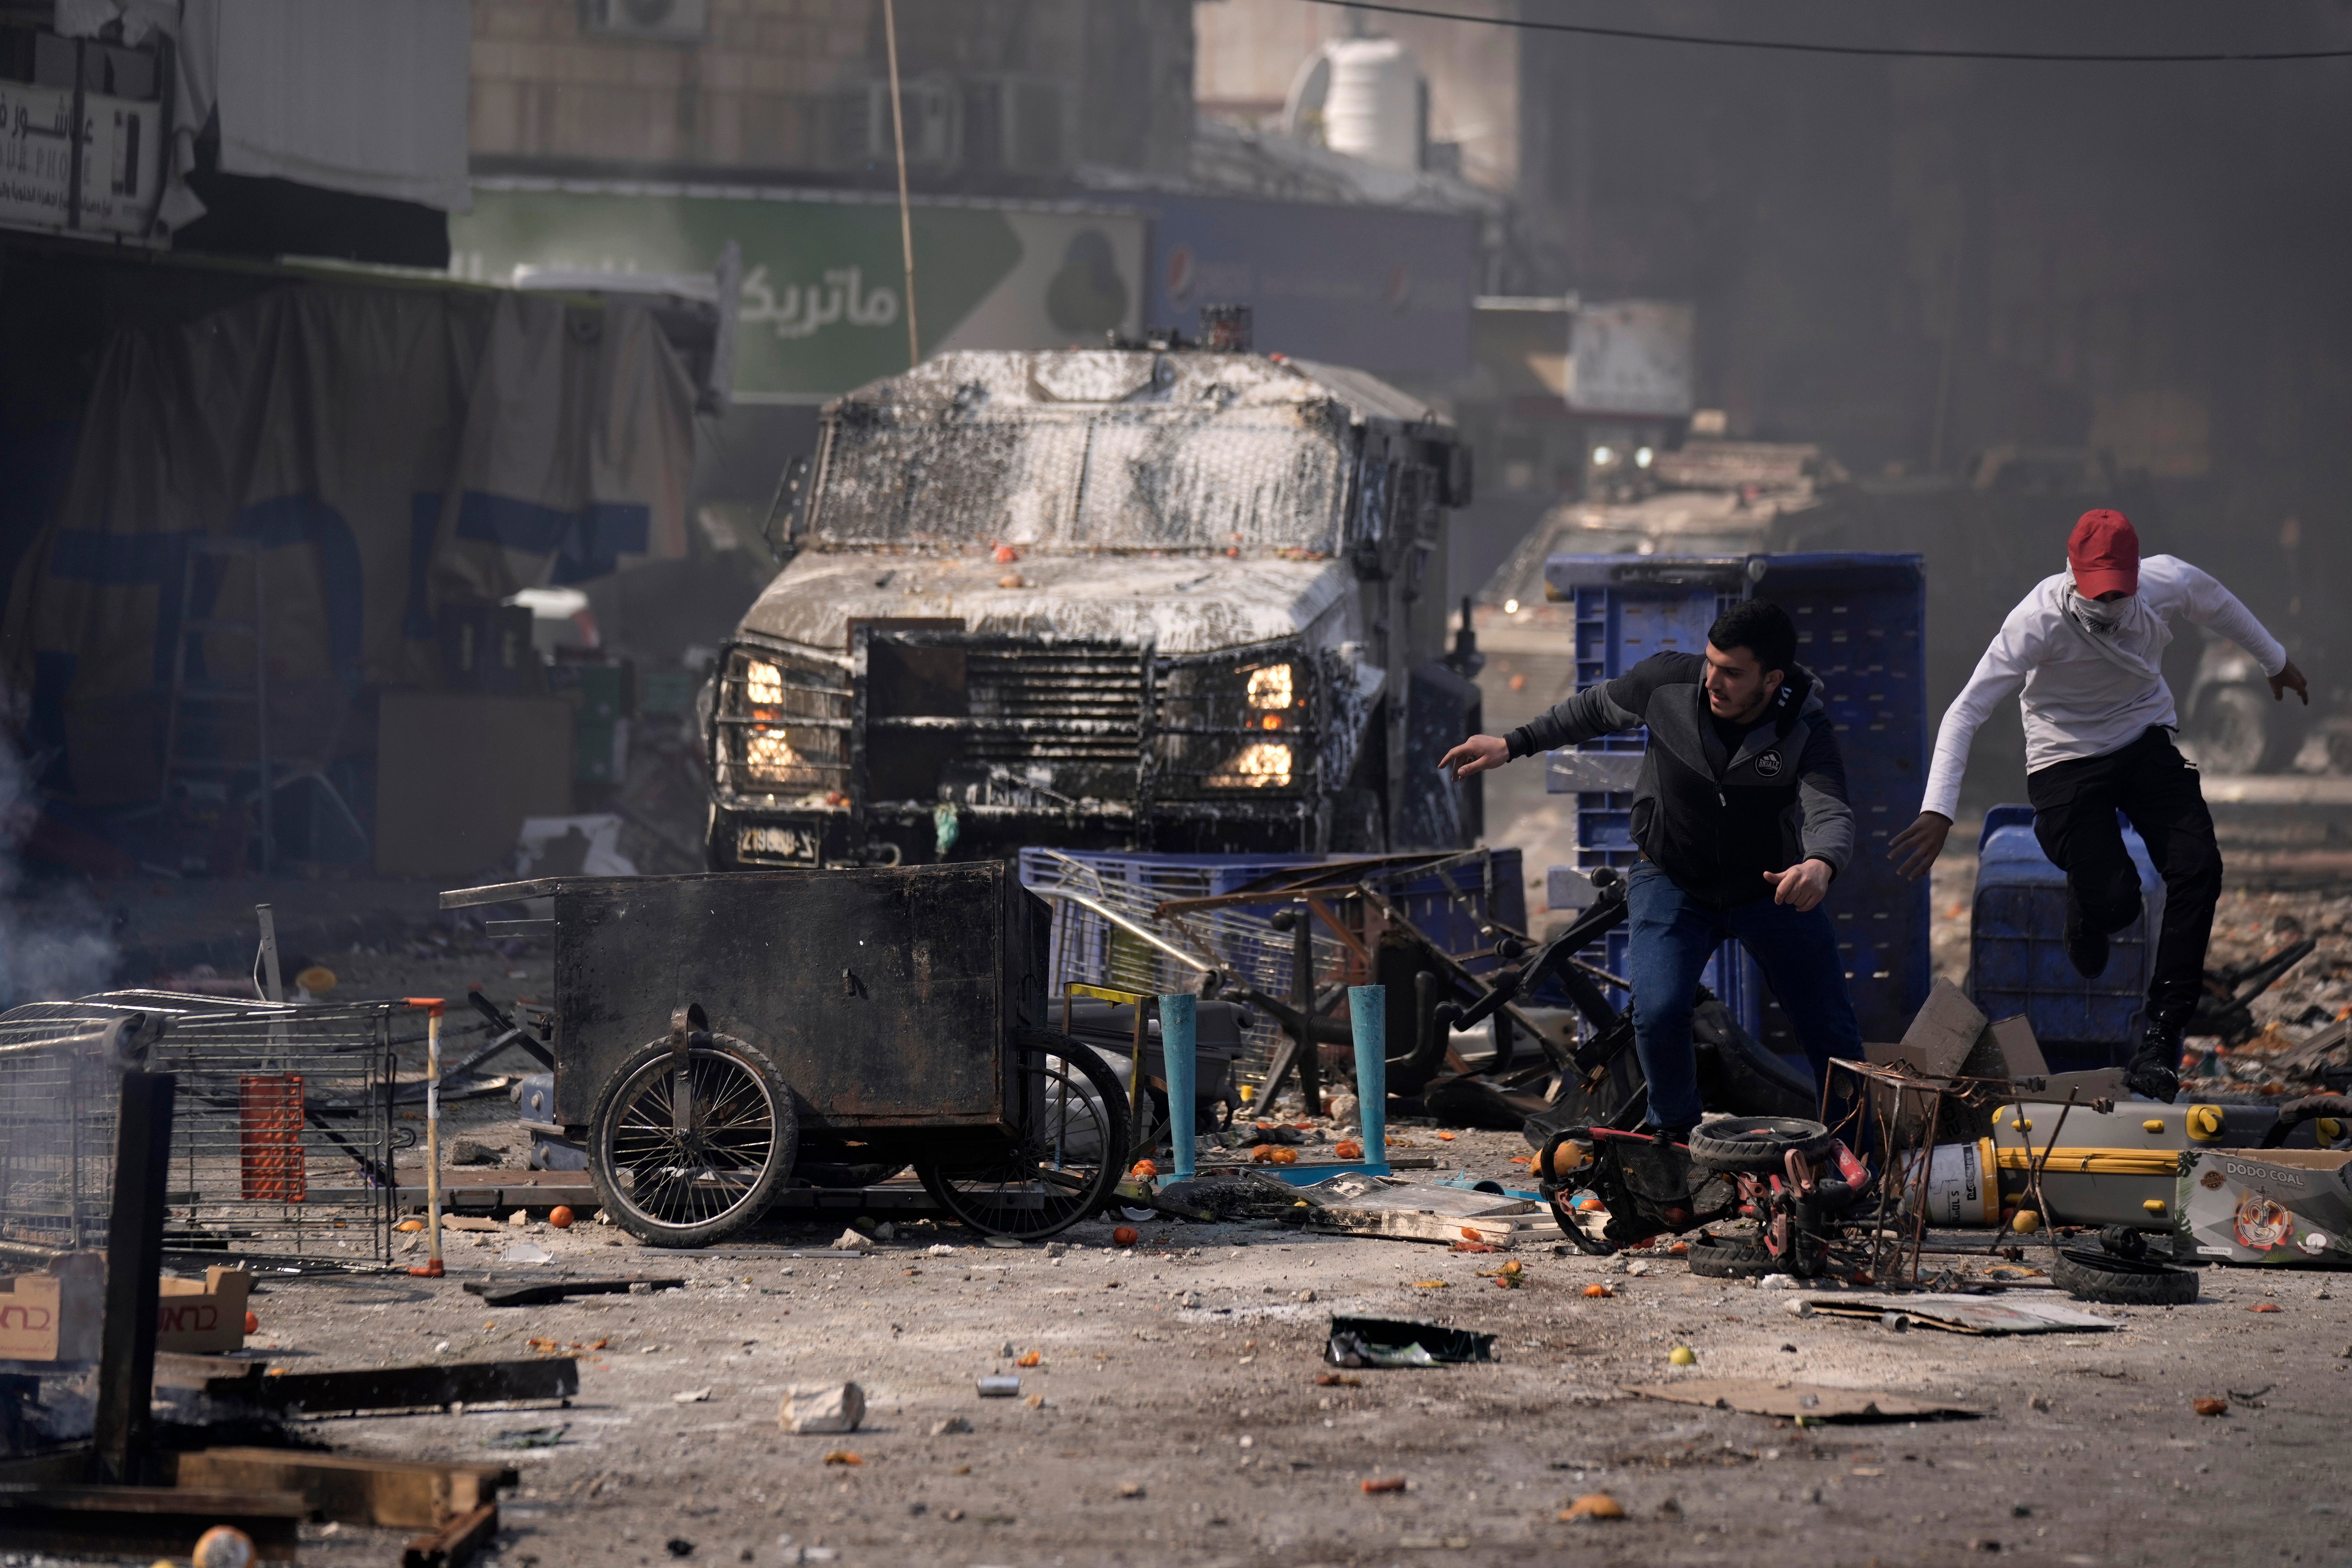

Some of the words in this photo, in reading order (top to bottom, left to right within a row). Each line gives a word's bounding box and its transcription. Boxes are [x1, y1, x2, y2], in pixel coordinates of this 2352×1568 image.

[36, 147, 91, 186] PHOE
[740, 264, 899, 338] ماتريك
[1759, 759, 1779, 770] BNSALE
[2201, 1175, 2226, 1186] ORIGINAL
[2226, 1162, 2267, 1179] DODO
[2269, 1169, 2305, 1186] COAL
